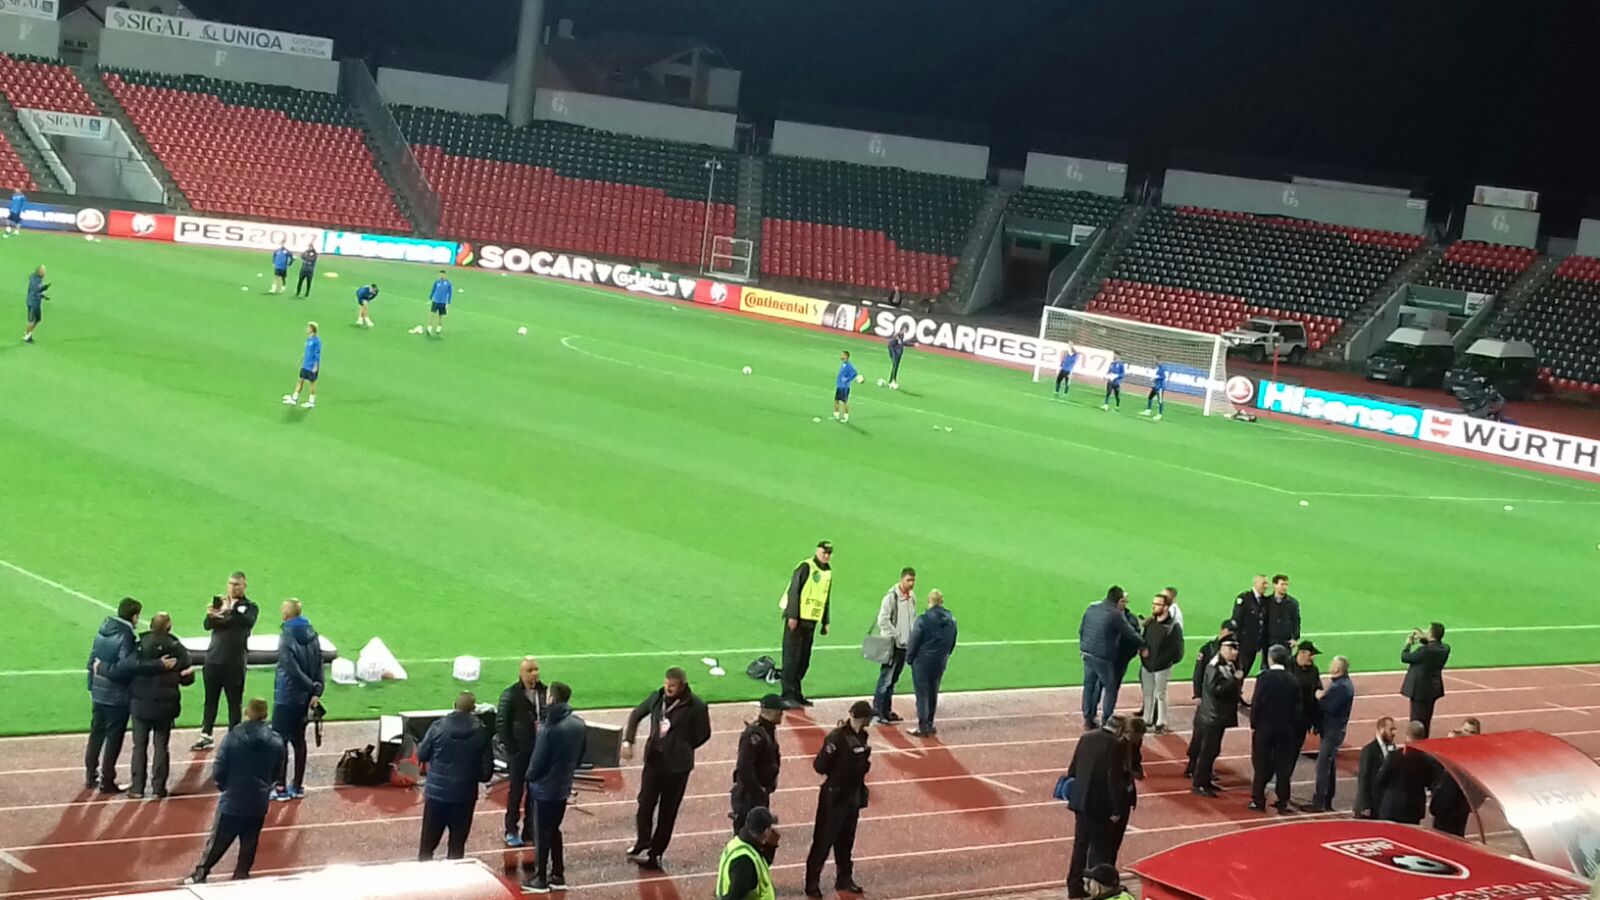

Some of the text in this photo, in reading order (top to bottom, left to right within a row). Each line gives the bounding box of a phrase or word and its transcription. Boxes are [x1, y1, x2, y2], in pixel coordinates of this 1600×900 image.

[18, 23, 32, 40] F
[126, 14, 282, 51] SIGAL UNIQA
[215, 50, 227, 66] F
[290, 45, 326, 57] AUSTRIA
[46, 113, 86, 128] SIGAL
[180, 220, 318, 248] PES 2017
[325, 230, 452, 265] Hisense
[478, 245, 594, 284] SOCAR
[612, 264, 677, 296] Carlsberg
[744, 292, 809, 315] Continental
[873, 311, 977, 353] SOCAR
[979, 333, 1037, 361] PES
[1040, 344, 1107, 372] 217
[1264, 380, 1419, 437] Hisense
[1463, 420, 1598, 469] WÜRTH
